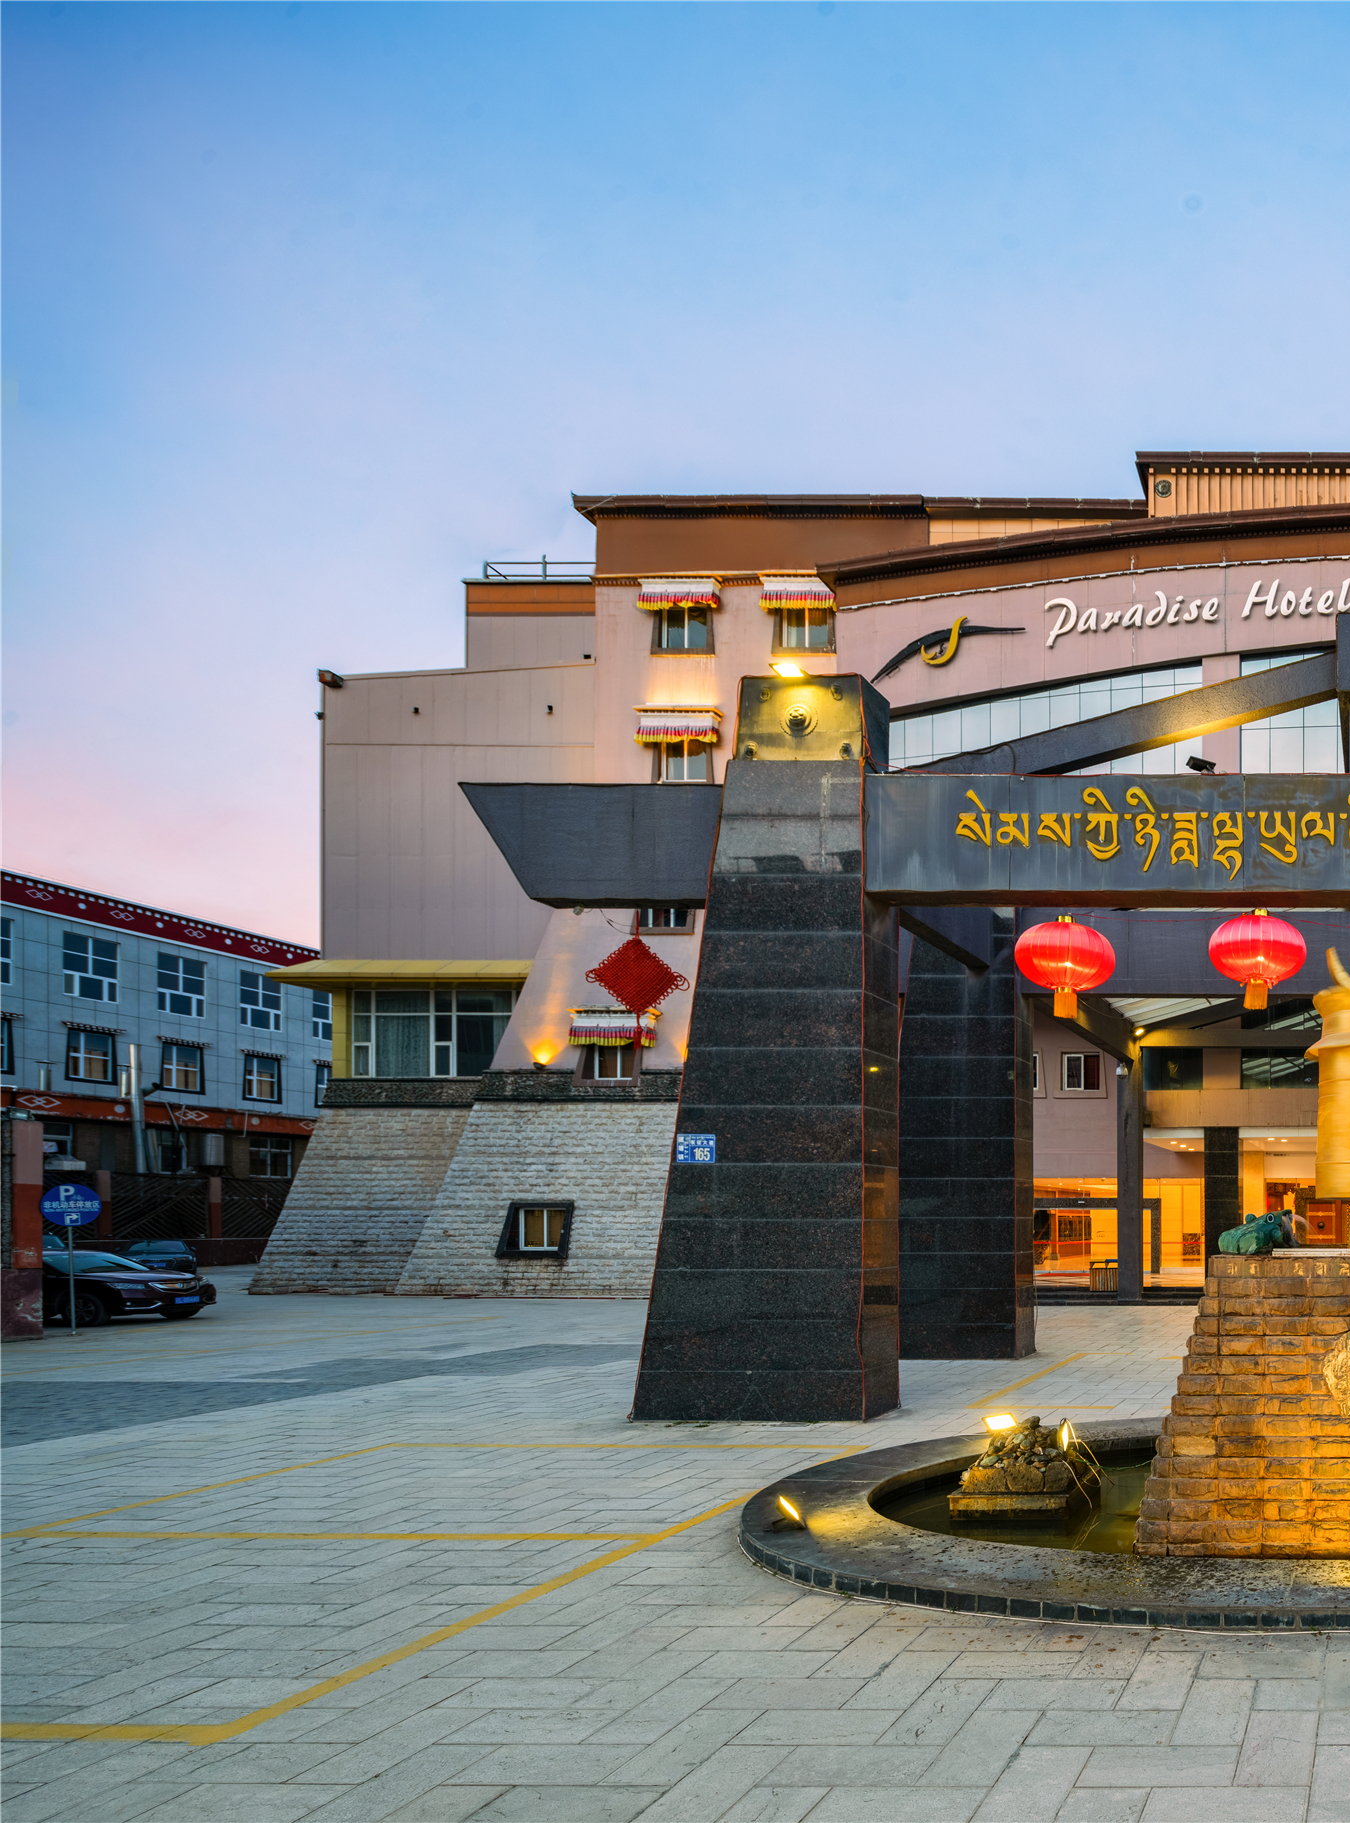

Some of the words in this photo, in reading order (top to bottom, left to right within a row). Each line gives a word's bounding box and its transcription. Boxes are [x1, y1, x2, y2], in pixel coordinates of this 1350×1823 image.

[1044, 590, 1219, 648] Paradise
[694, 1148, 710, 1160] 165
[59, 1185, 75, 1201] P
[43, 1200, 100, 1208] 非机动车停放区
